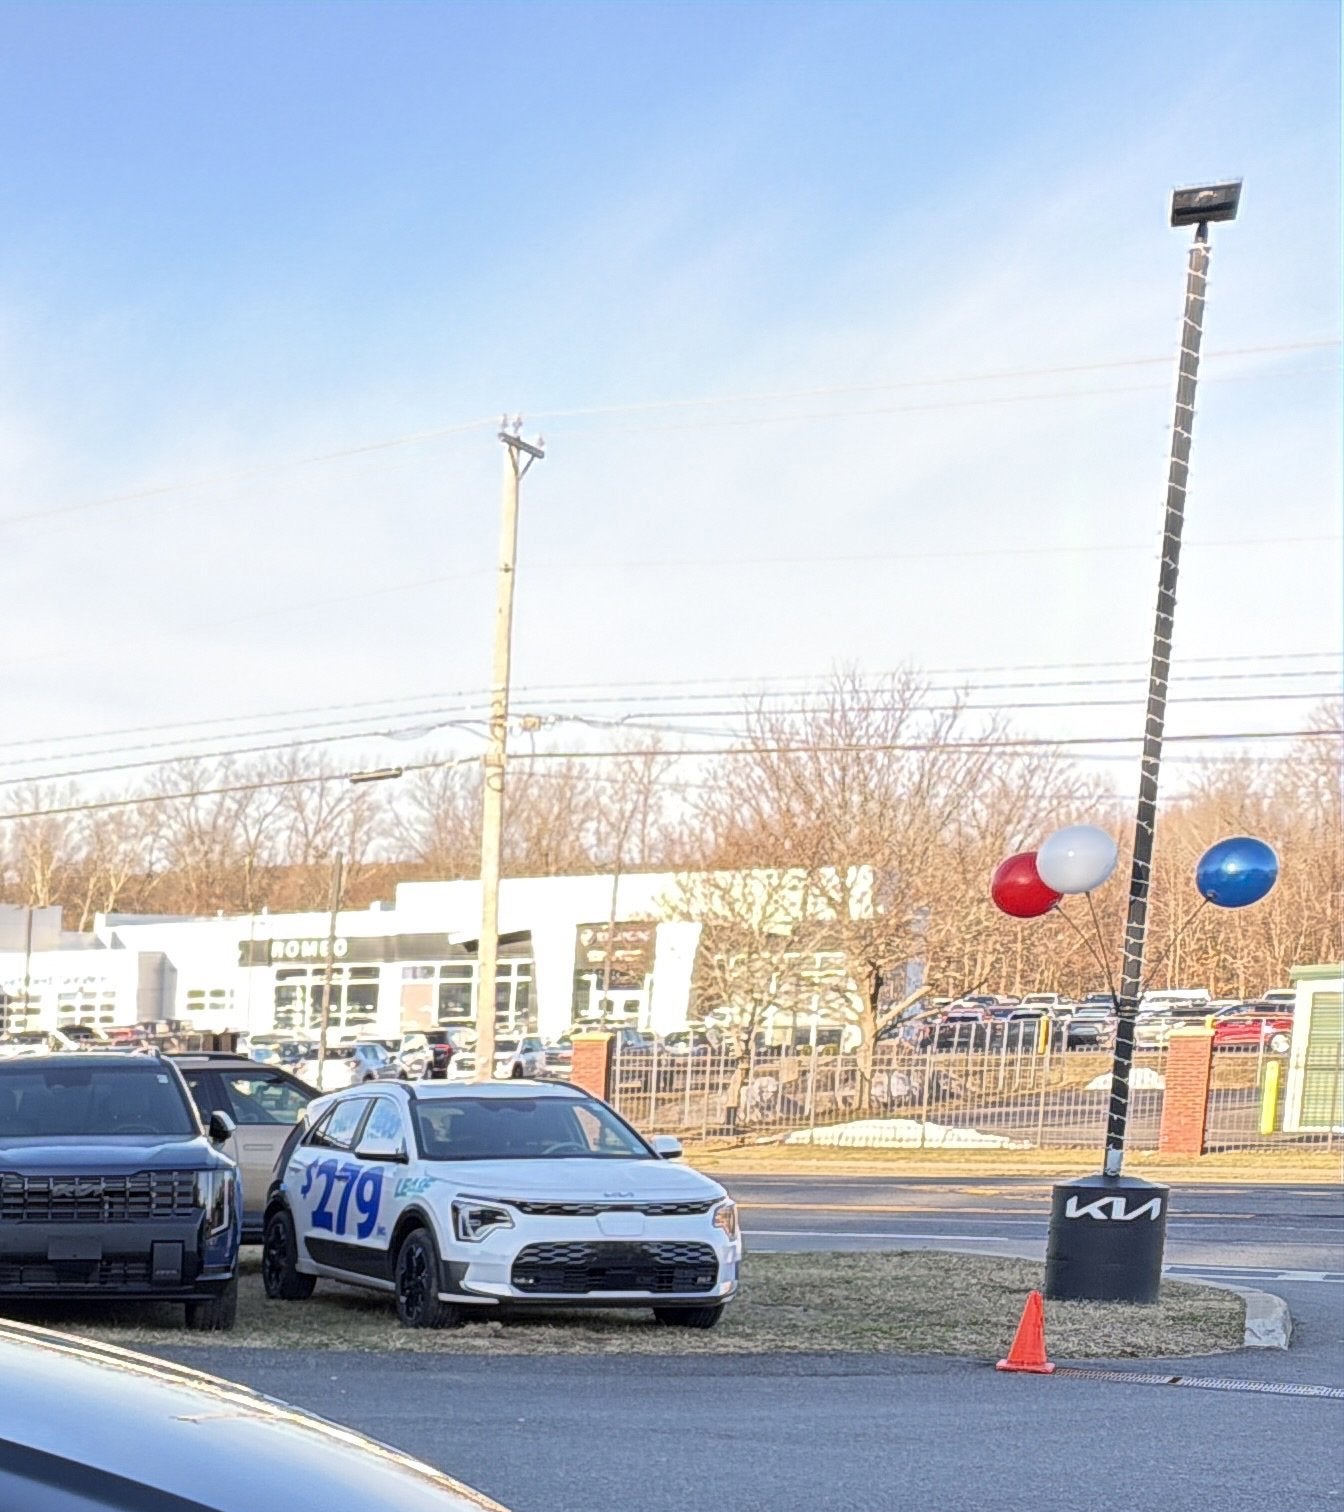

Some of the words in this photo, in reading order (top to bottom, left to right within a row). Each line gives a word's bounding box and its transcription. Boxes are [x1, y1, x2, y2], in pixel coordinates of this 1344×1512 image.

[271, 939, 348, 958] ROMEO
[300, 1157, 385, 1240] $279
[1065, 1195, 1162, 1221] KIA
